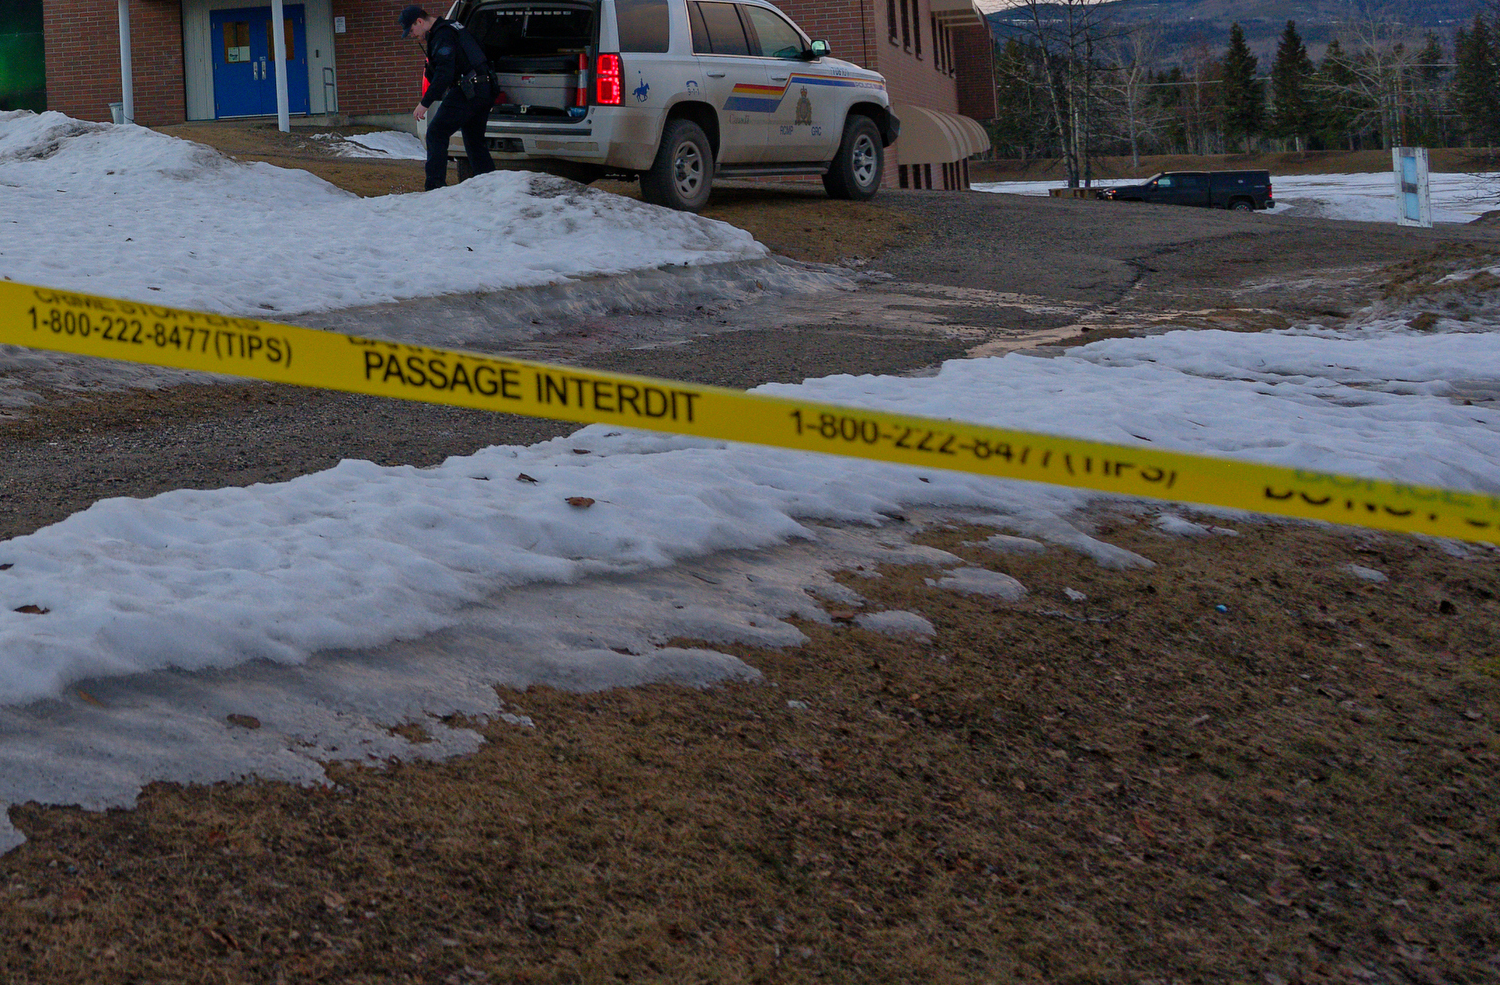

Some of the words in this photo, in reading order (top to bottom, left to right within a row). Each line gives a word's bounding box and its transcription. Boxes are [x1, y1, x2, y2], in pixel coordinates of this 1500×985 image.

[780, 125, 794, 135] RCMP
[811, 126, 822, 136] GRC
[28, 305, 292, 368] 1-800-222-8477(TIPS)
[364, 350, 523, 401] PASSAGE
[536, 372, 701, 423] INTERDIT
